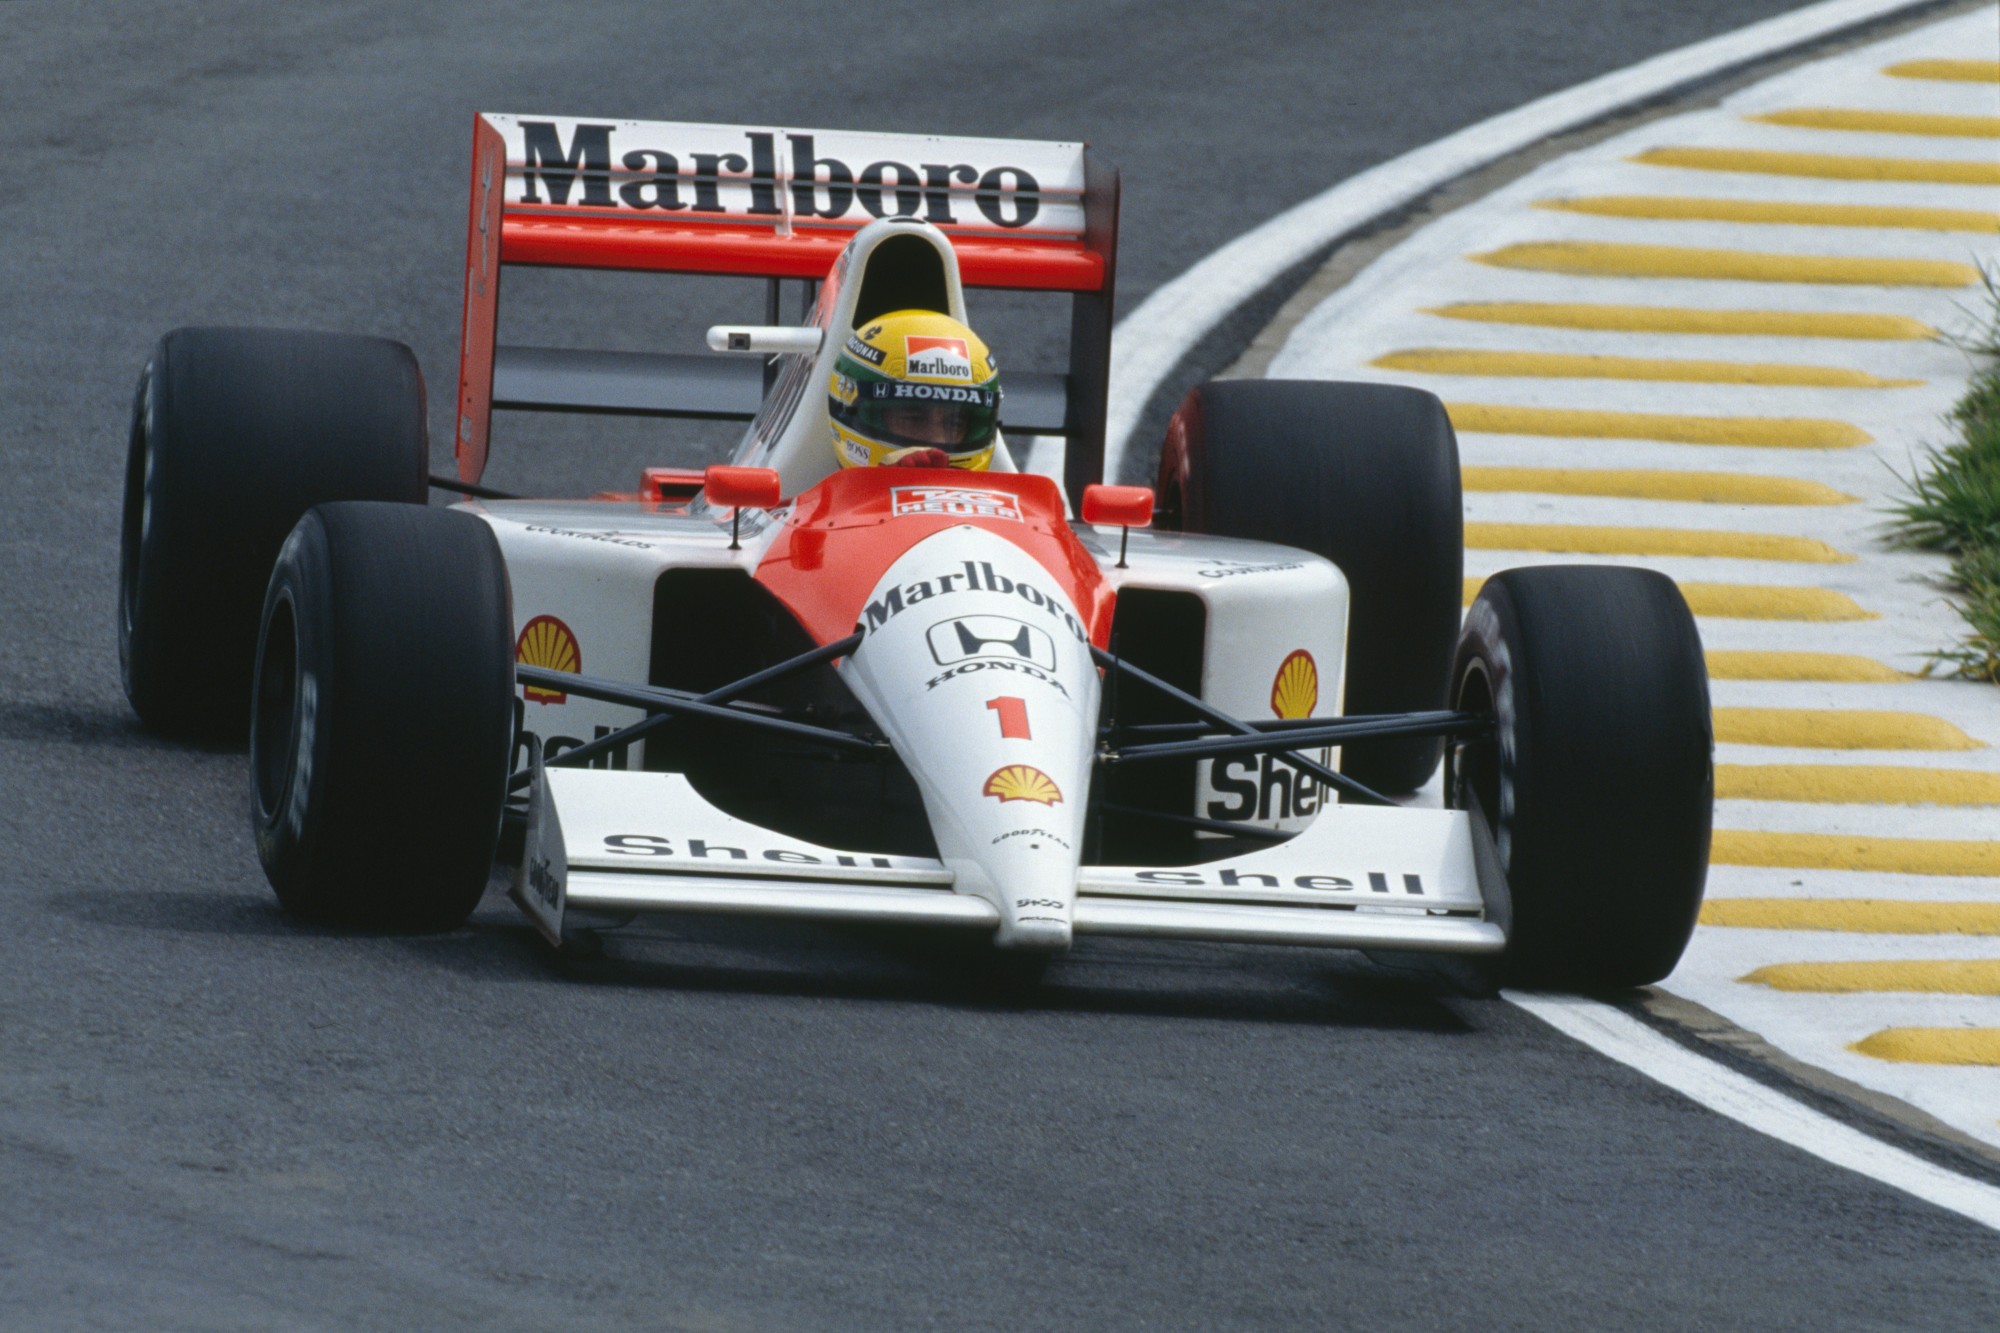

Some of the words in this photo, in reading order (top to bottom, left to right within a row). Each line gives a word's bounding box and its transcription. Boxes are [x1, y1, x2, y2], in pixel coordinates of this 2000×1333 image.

[518, 121, 1040, 228] Marlboro
[908, 357, 969, 377] Marlboro
[895, 385, 981, 404] HONDA
[901, 502, 1015, 519] HEUER
[864, 560, 1087, 644] Marlboro
[926, 661, 1072, 701] HONDA
[986, 696, 1032, 741] 1
[603, 834, 893, 869] Shell
[1135, 869, 1425, 896] Shell
